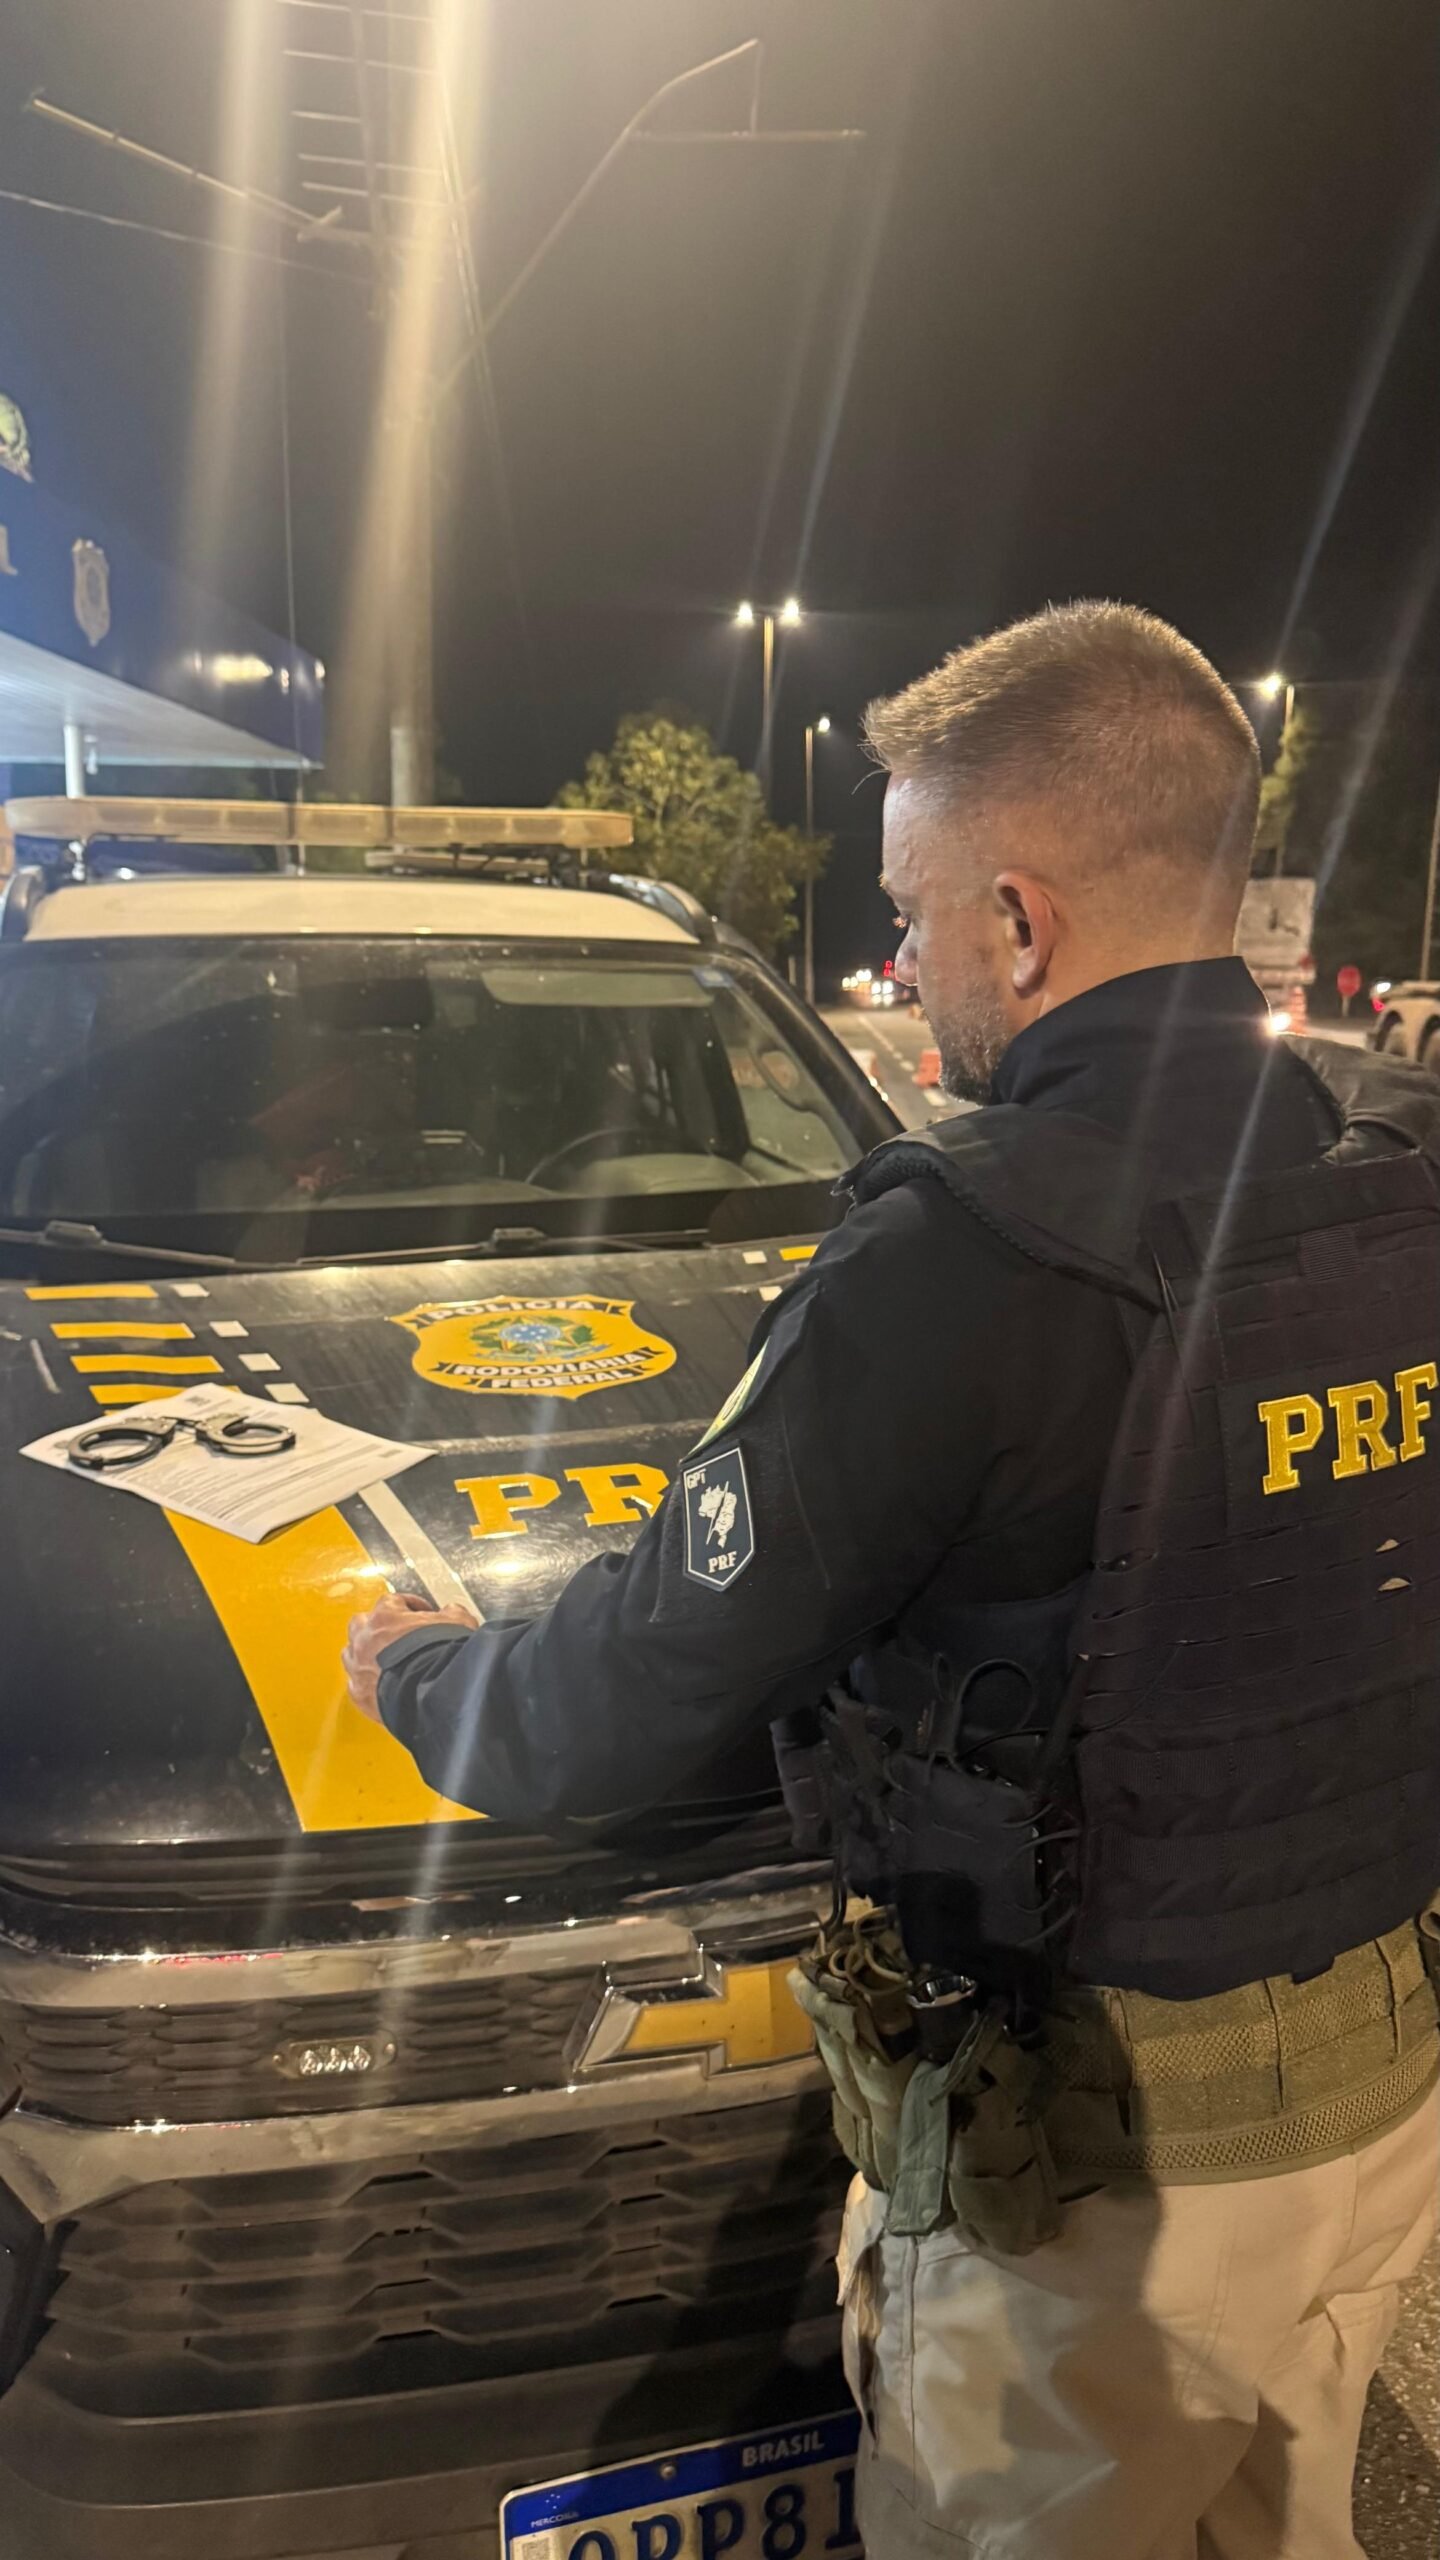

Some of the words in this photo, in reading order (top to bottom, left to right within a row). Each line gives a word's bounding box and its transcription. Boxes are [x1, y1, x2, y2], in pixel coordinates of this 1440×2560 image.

[427, 1299, 596, 1320] POLICIA
[453, 1353, 647, 1376] RODOVIARIA
[491, 1370, 634, 1388] FEDERAL
[1258, 1362, 1438, 1495] PRF
[708, 1551, 737, 1573] PRF
[742, 2431, 825, 2468] BRASIL
